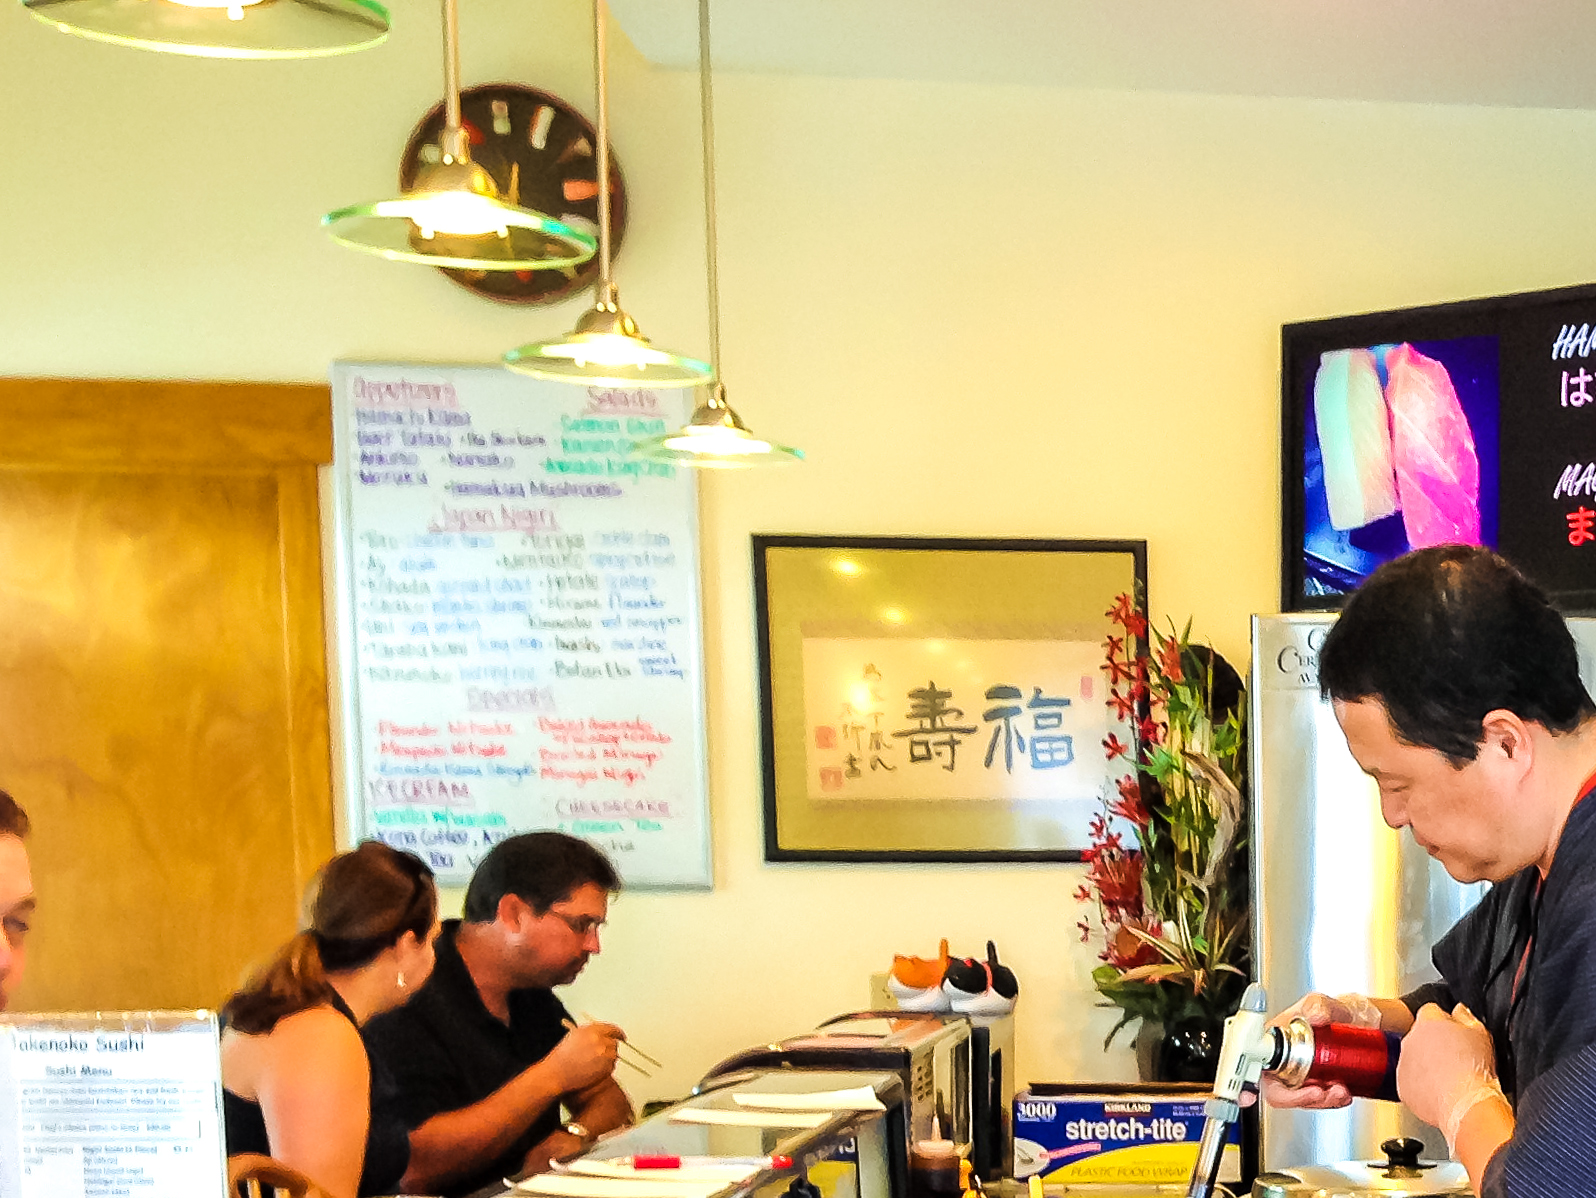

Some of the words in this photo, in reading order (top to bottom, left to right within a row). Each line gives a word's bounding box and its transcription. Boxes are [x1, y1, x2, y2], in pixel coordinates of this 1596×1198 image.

[96, 1033, 145, 1052] Sushi
[1103, 1102, 1152, 1113] KIRKLAND
[1065, 1117, 1188, 1142] stretch-tite
[1070, 1166, 1115, 1178] PLASTIC
[1116, 1166, 1150, 1178] FOOD
[1152, 1166, 1188, 1178] WRAP
